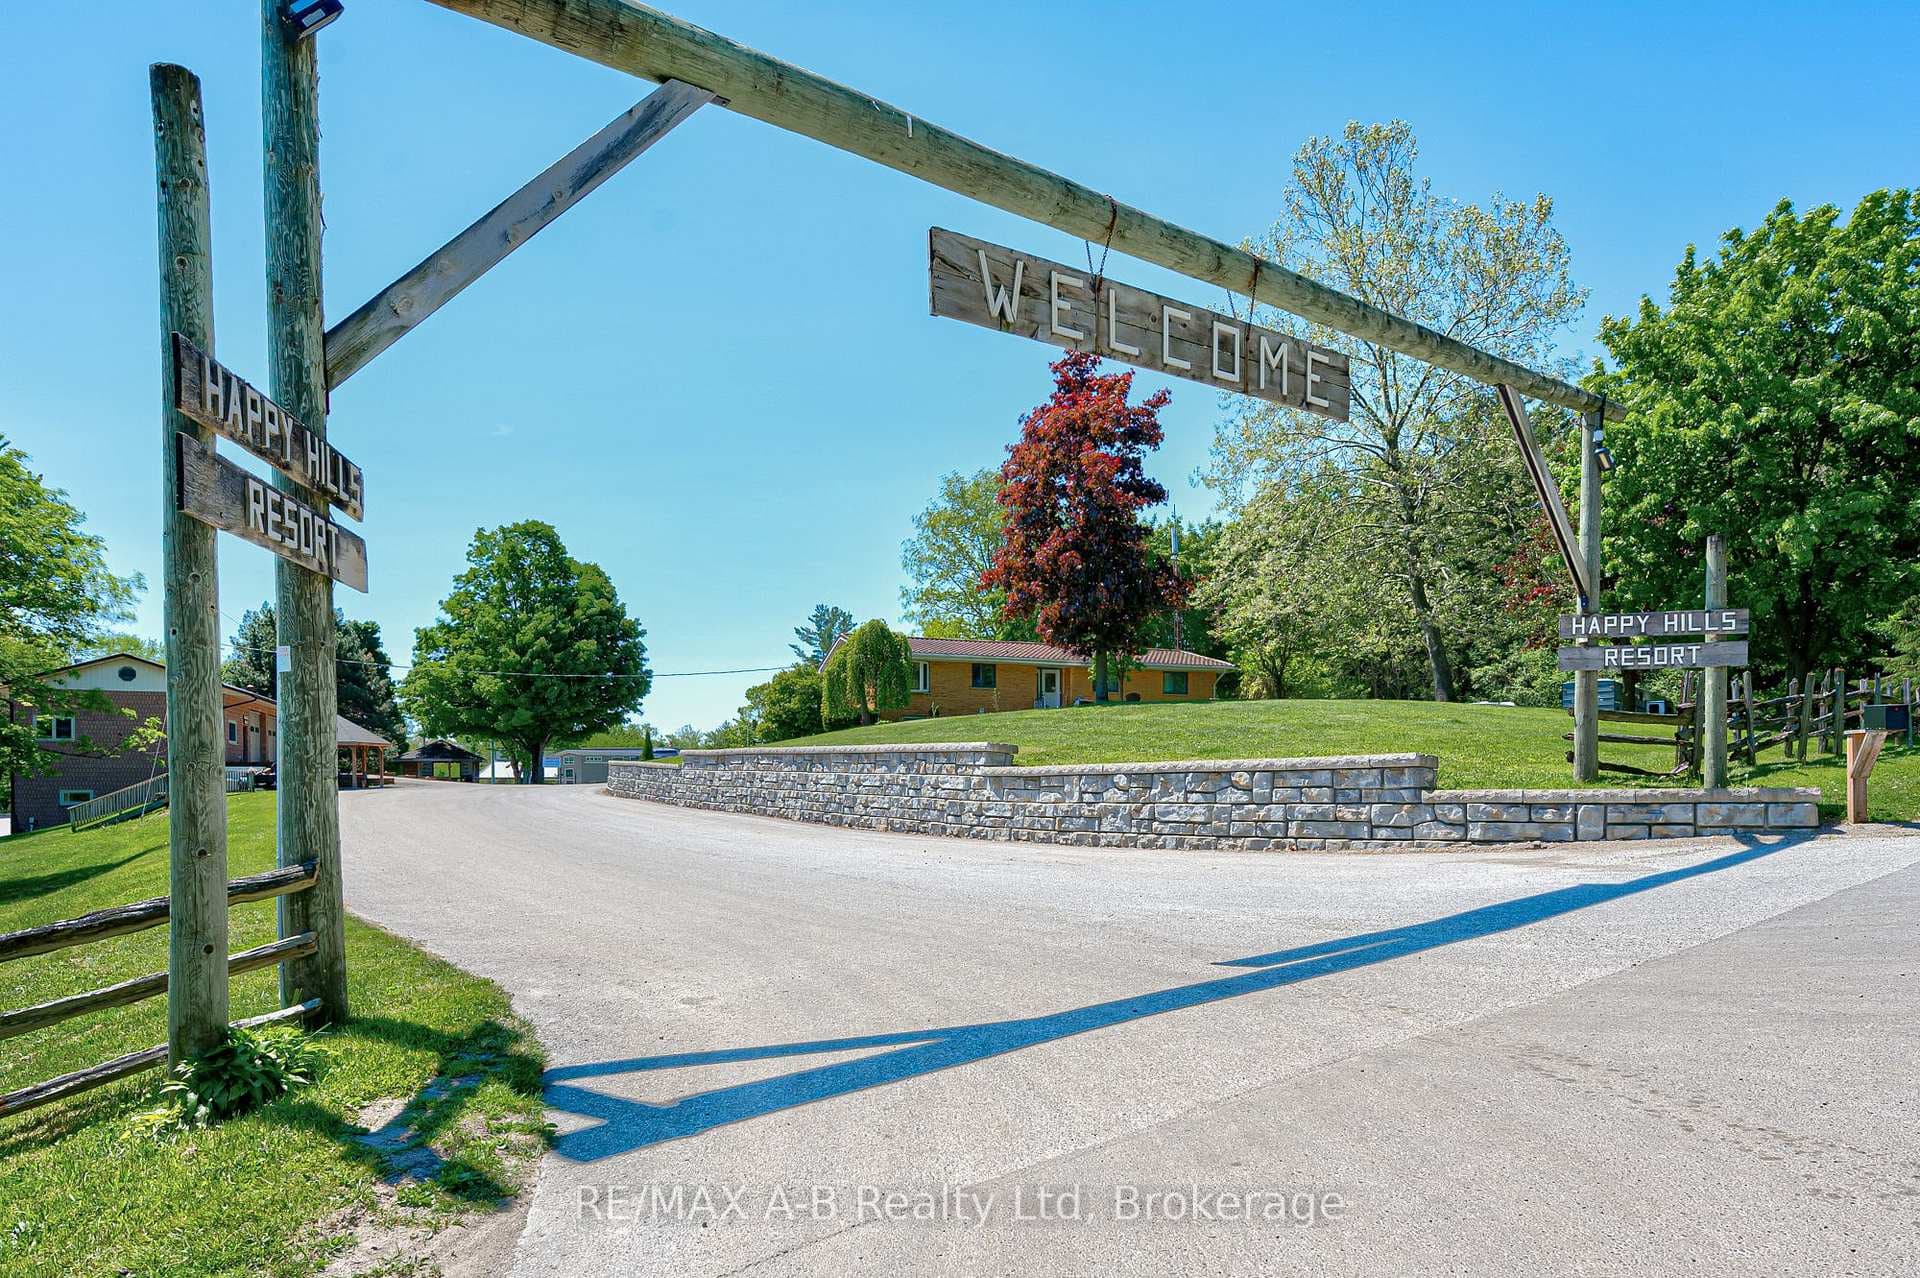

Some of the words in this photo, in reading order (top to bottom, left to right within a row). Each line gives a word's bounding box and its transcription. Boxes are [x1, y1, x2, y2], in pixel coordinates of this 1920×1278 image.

[977, 249, 1330, 408] WELCOME
[203, 355, 294, 463] HAPPY
[306, 430, 361, 503] HILLS
[247, 478, 339, 568] RESORT
[1571, 614, 1650, 635] HAPPY
[1664, 611, 1737, 633] HILLS
[1604, 645, 1701, 667] RESORT
